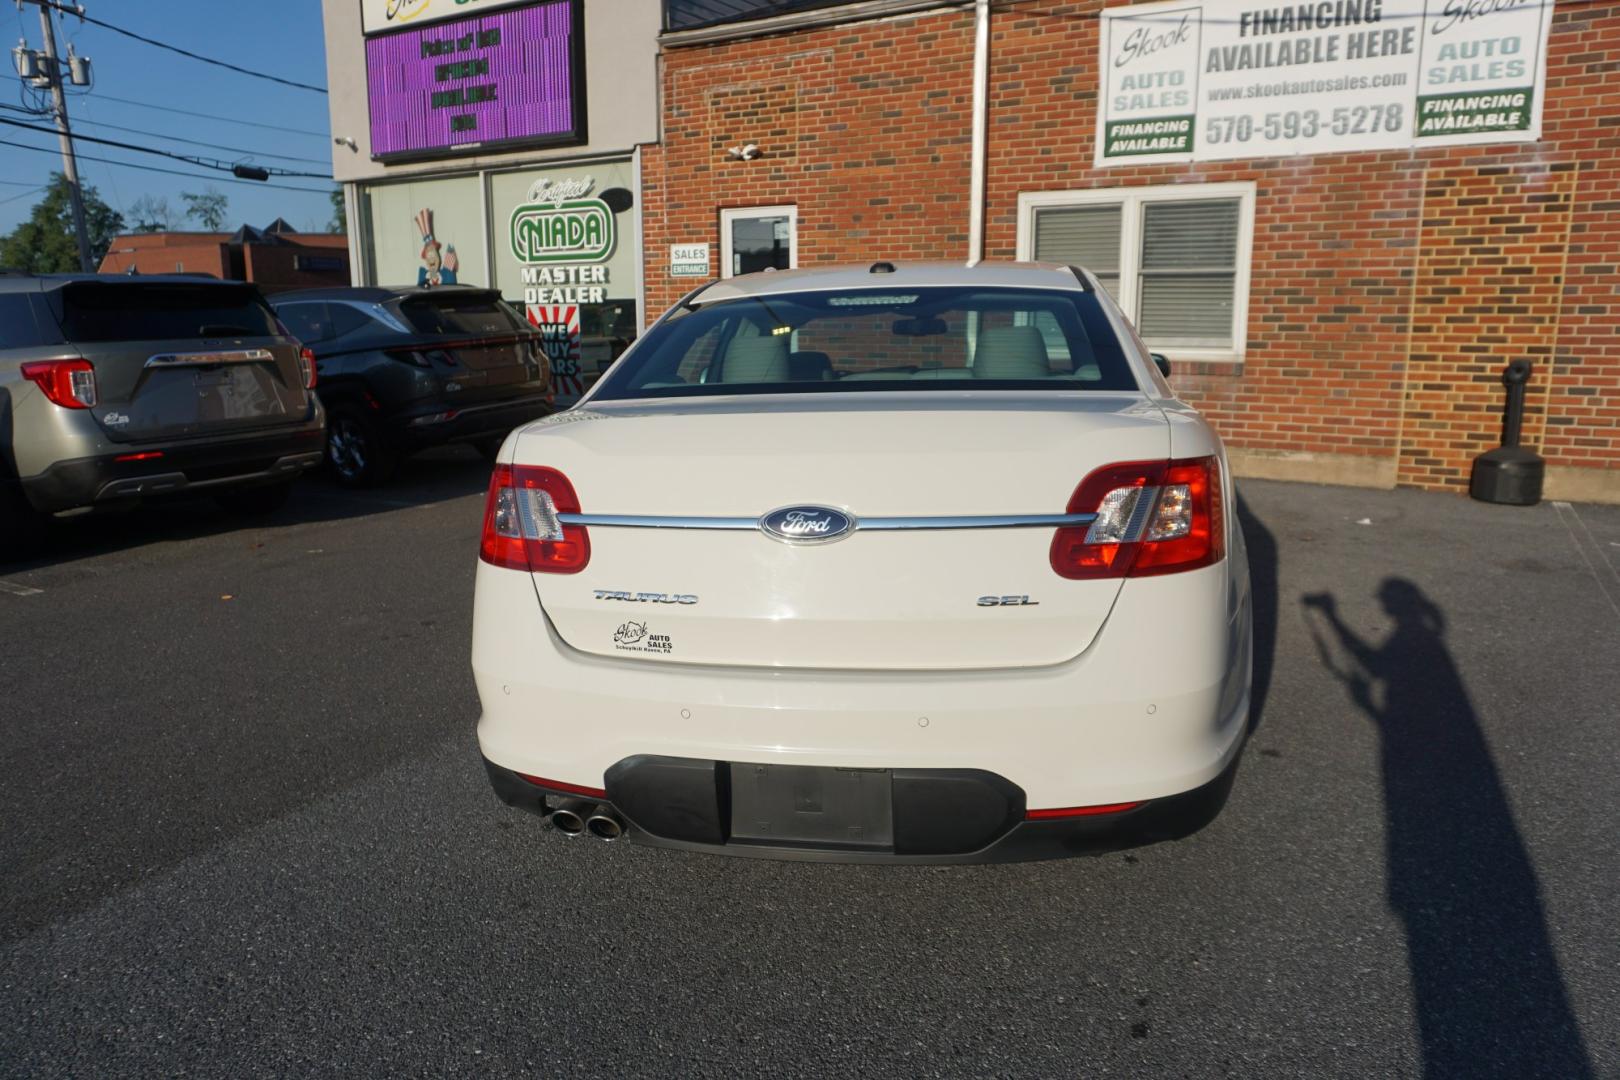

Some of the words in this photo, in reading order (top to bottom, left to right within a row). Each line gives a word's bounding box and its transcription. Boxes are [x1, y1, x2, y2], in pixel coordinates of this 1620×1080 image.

[1240, 0, 1383, 37] FINANCING
[1114, 14, 1190, 68] Skook
[1206, 34, 1341, 73] AVAILABLE
[1346, 26, 1416, 60] HERE
[1437, 36, 1522, 62] AUTO
[1120, 69, 1185, 91] AUTO
[1427, 60, 1526, 85] SALES
[1207, 72, 1408, 102] www.skookautosales.com
[1113, 90, 1190, 112] SALES
[1423, 93, 1526, 114] FINANCING
[1110, 120, 1190, 137] FINANCING
[1206, 102, 1404, 145] 570-593-5278
[1421, 112, 1522, 132] AVAILABLE
[1110, 136, 1187, 152] AVAILABLE
[518, 211, 604, 250] NIADA
[674, 249, 706, 260] SALES
[521, 264, 605, 284] MASTER
[672, 264, 707, 274] ENTRANCE
[524, 286, 604, 304] DEALER
[540, 323, 568, 341] WE
[549, 359, 577, 375] ARS
[780, 510, 833, 533] Ford
[593, 589, 699, 605] TAURUS
[976, 594, 1040, 607] SEL
[613, 620, 648, 642] Skook
[649, 634, 670, 642] AUTO
[647, 641, 673, 649] SALES
